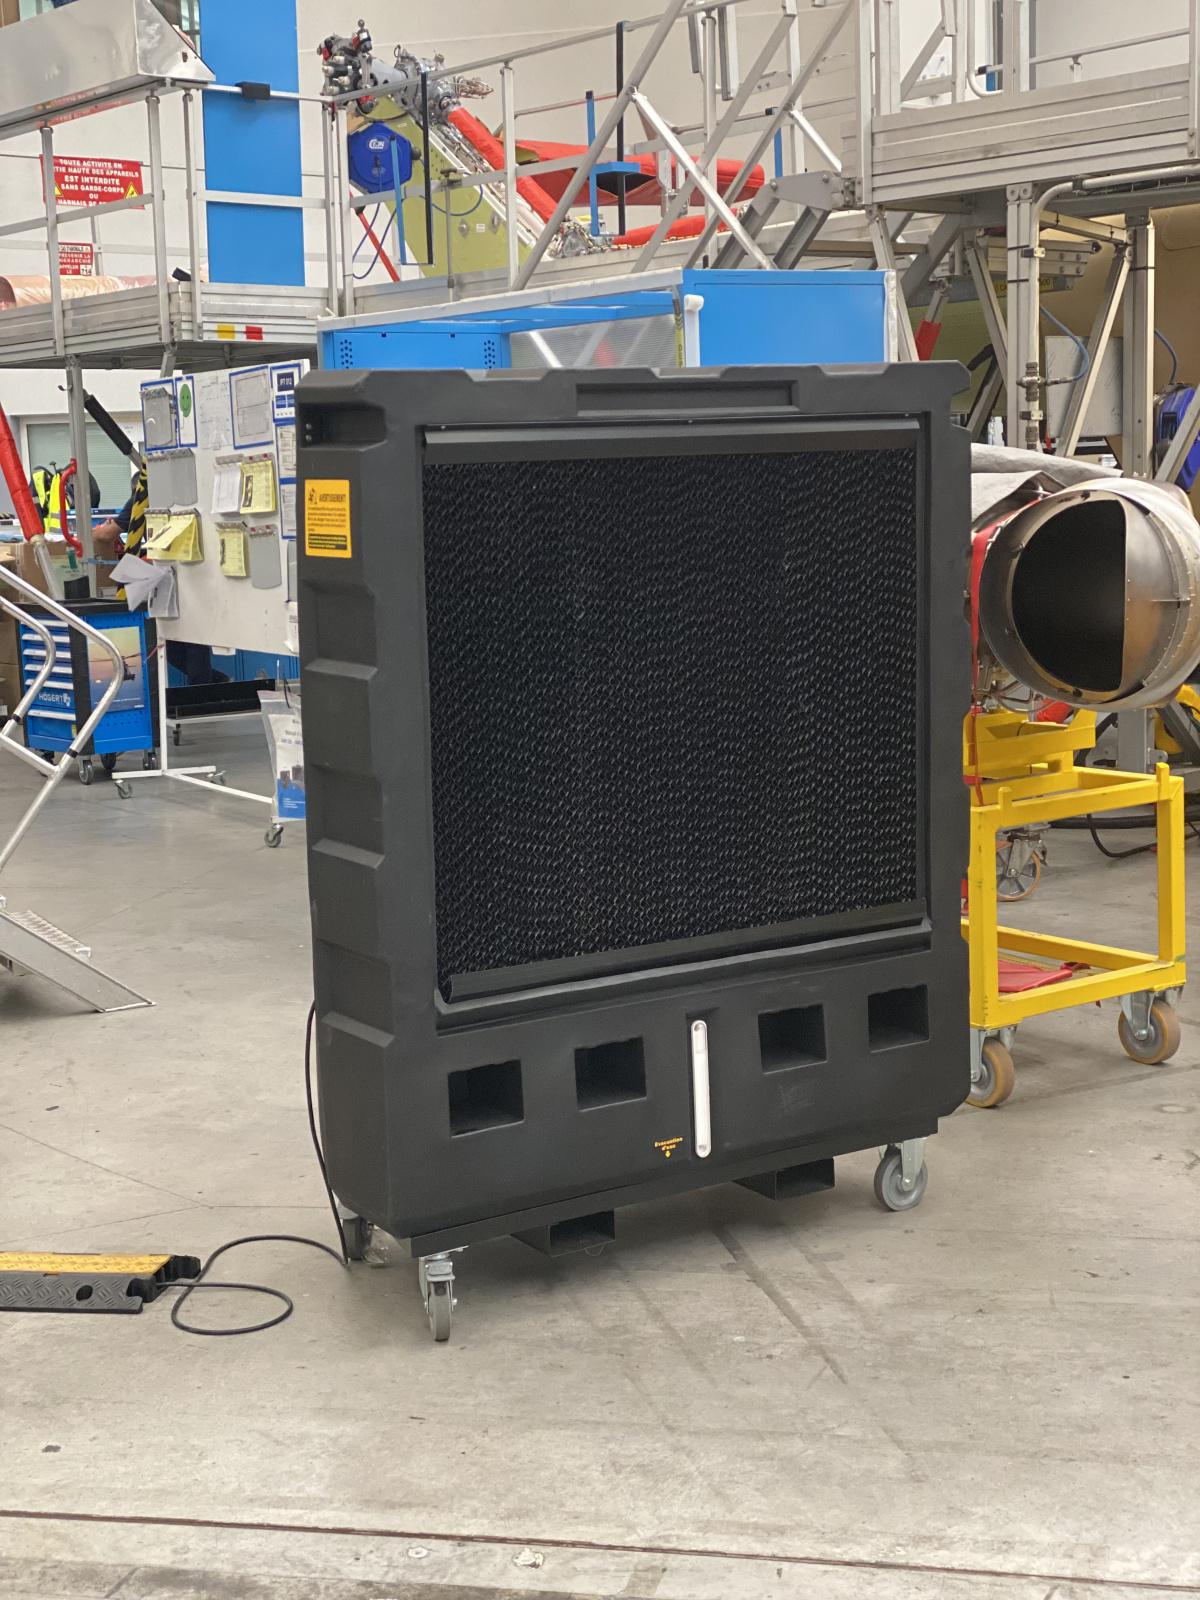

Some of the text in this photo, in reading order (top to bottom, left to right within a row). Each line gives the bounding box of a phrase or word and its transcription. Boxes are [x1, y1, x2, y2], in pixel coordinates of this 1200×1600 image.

[105, 170, 139, 178] APPAREILS
[64, 175, 120, 185] EST INTERDITE
[60, 183, 125, 193] SANS GARDE-CORPS
